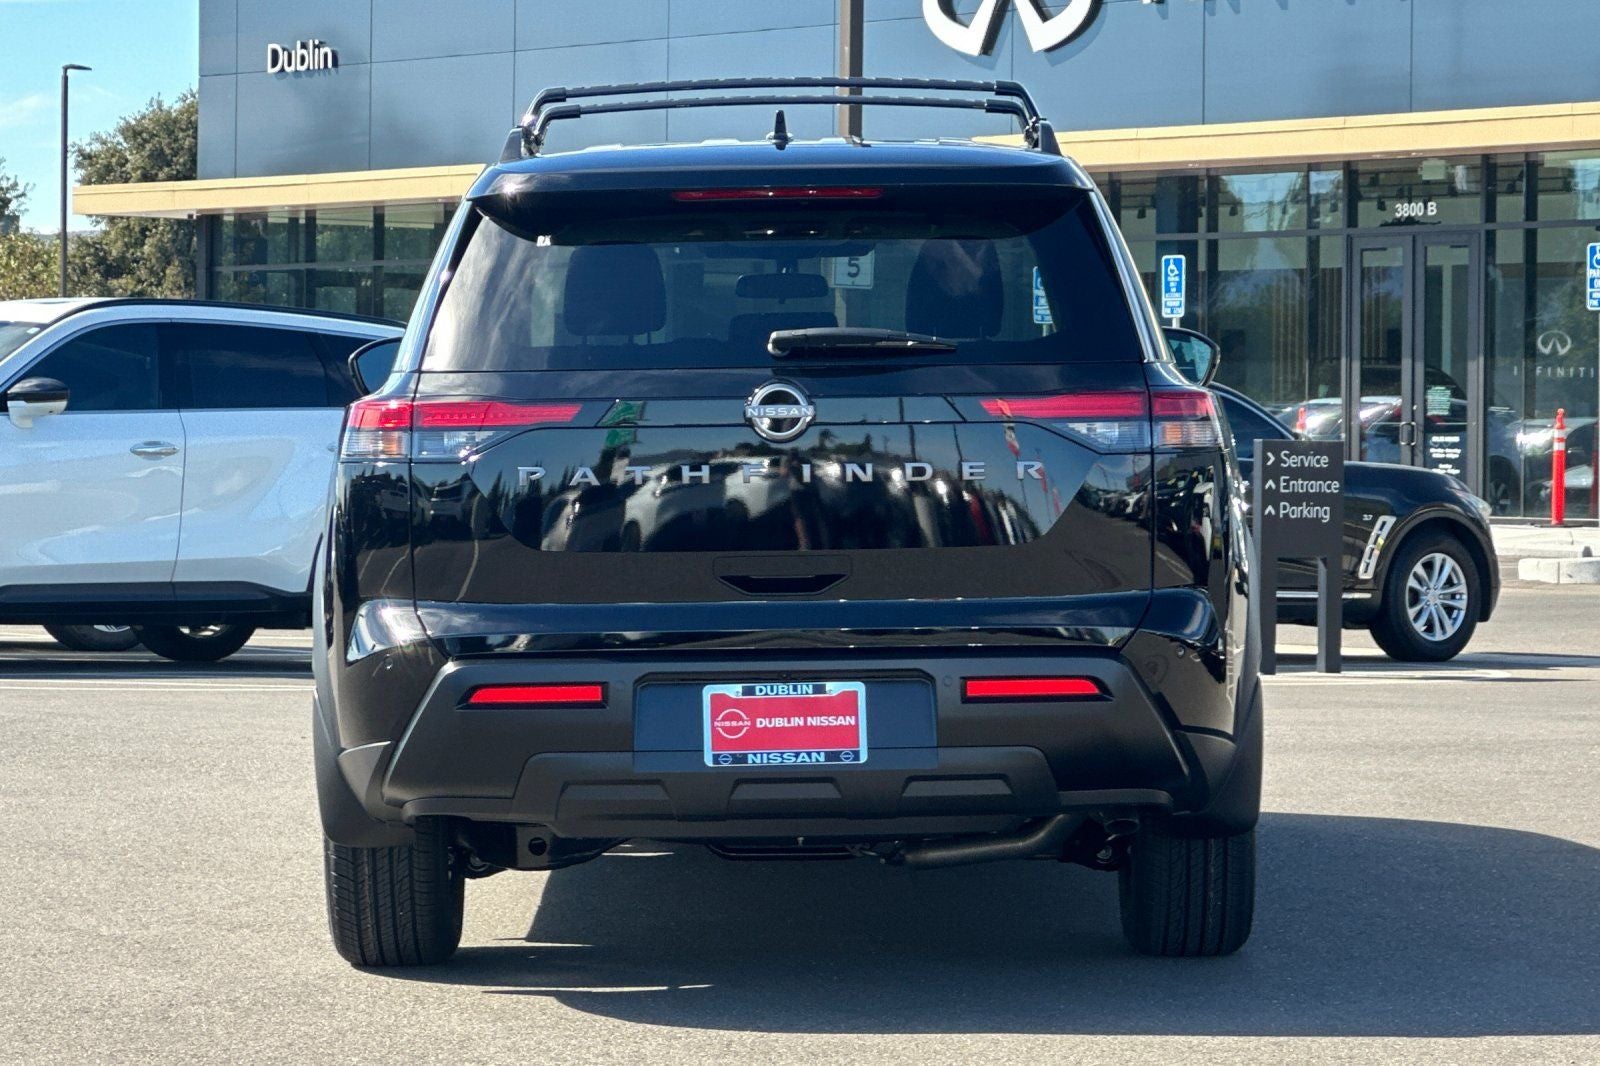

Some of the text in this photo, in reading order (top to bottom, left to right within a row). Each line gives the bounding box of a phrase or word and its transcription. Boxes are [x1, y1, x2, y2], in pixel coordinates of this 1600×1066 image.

[267, 39, 333, 74] Dublin
[1395, 201, 1437, 218] 3800 B
[847, 257, 860, 278] 5
[1513, 365, 1595, 378] IFINITI
[748, 407, 812, 416] NISSAN
[1280, 450, 1329, 468] Service
[517, 461, 1043, 486] PATHFINDER
[1280, 476, 1340, 493] Entrance
[1280, 502, 1331, 523] Parking
[755, 684, 814, 696] DUBLIN
[756, 715, 855, 728] DUBLIN NISSAN
[747, 752, 825, 764] NISSAN
